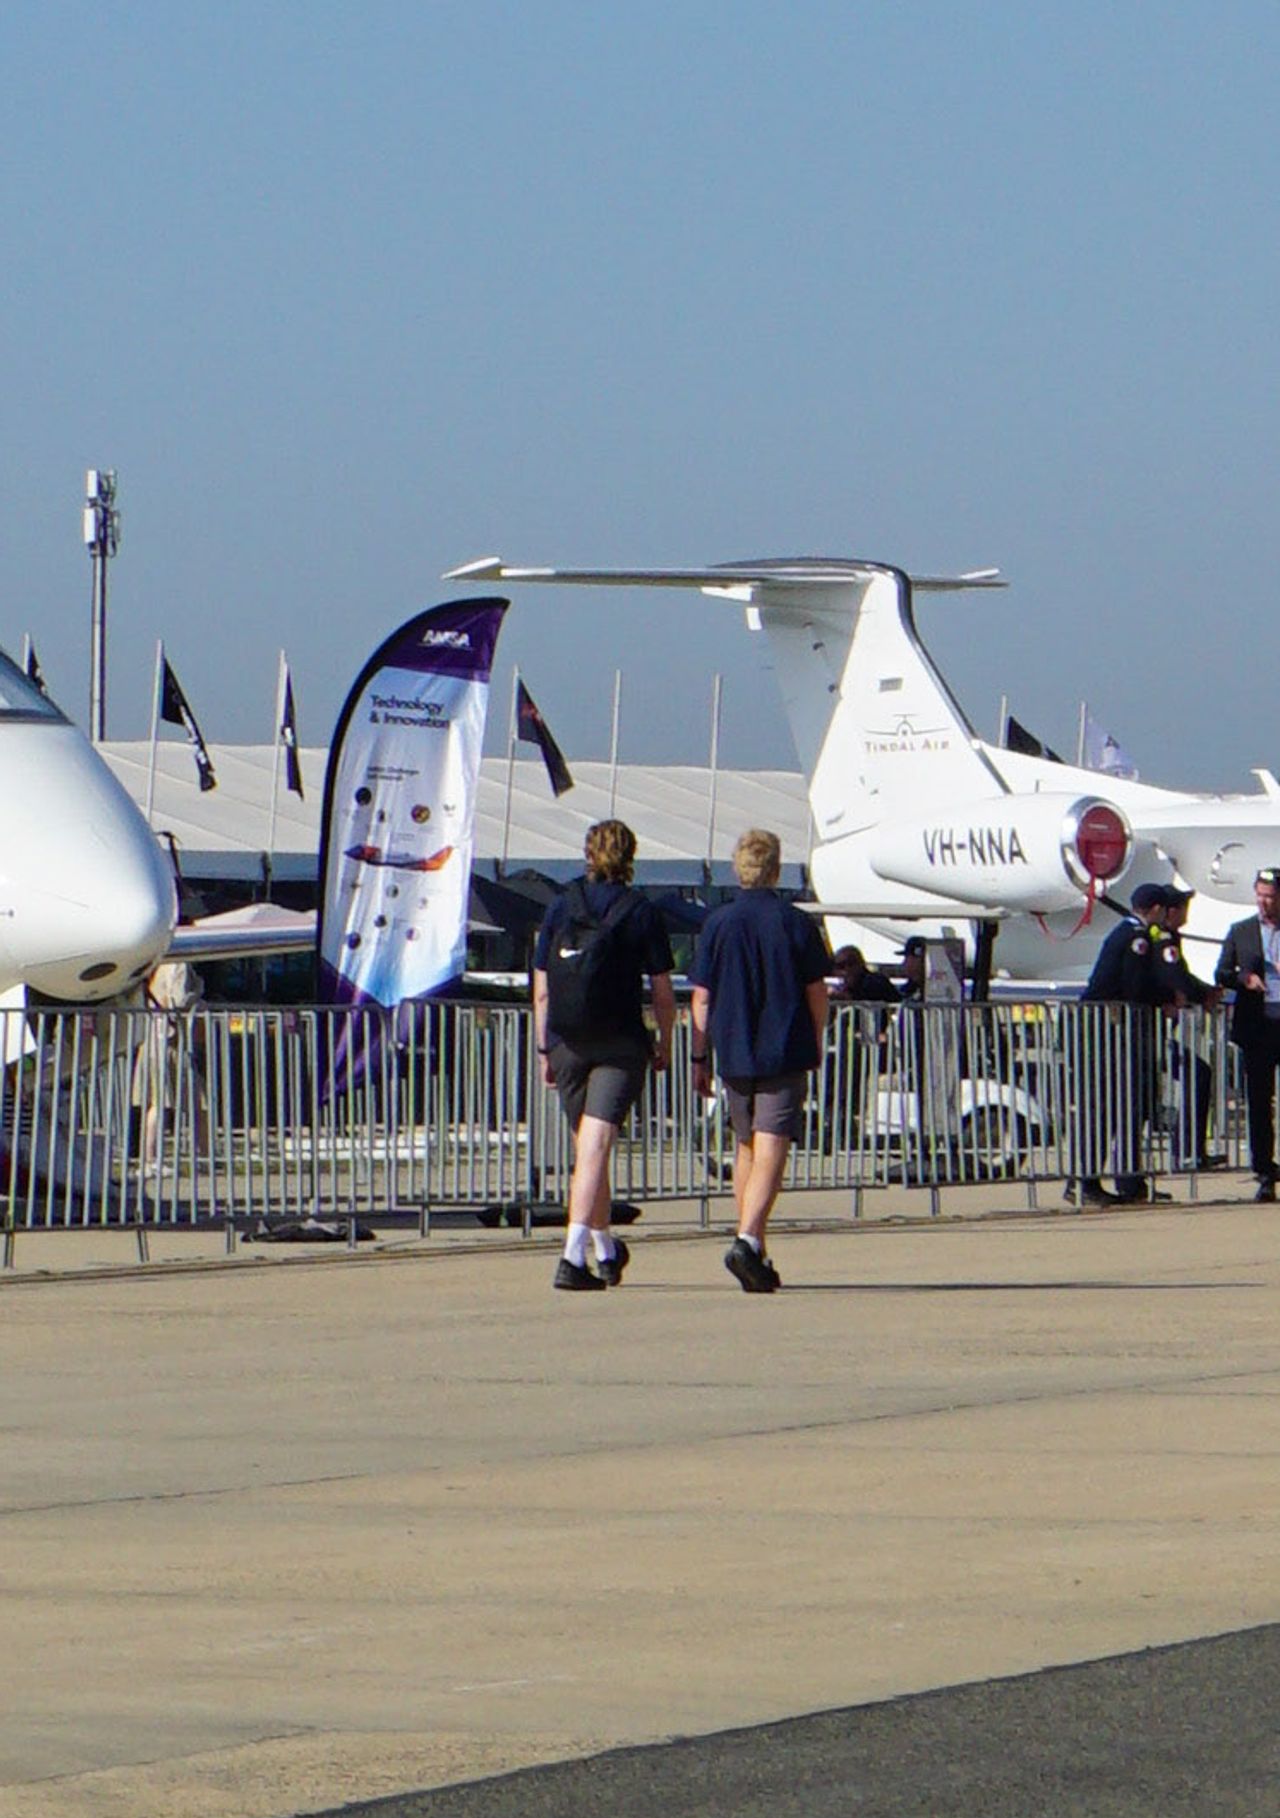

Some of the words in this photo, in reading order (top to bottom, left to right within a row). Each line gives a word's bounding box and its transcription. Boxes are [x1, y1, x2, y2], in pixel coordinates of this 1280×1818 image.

[371, 694, 444, 715] Technology
[370, 711, 380, 724] &
[384, 712, 450, 729] Innovation
[924, 827, 1028, 865] VH-NNA
